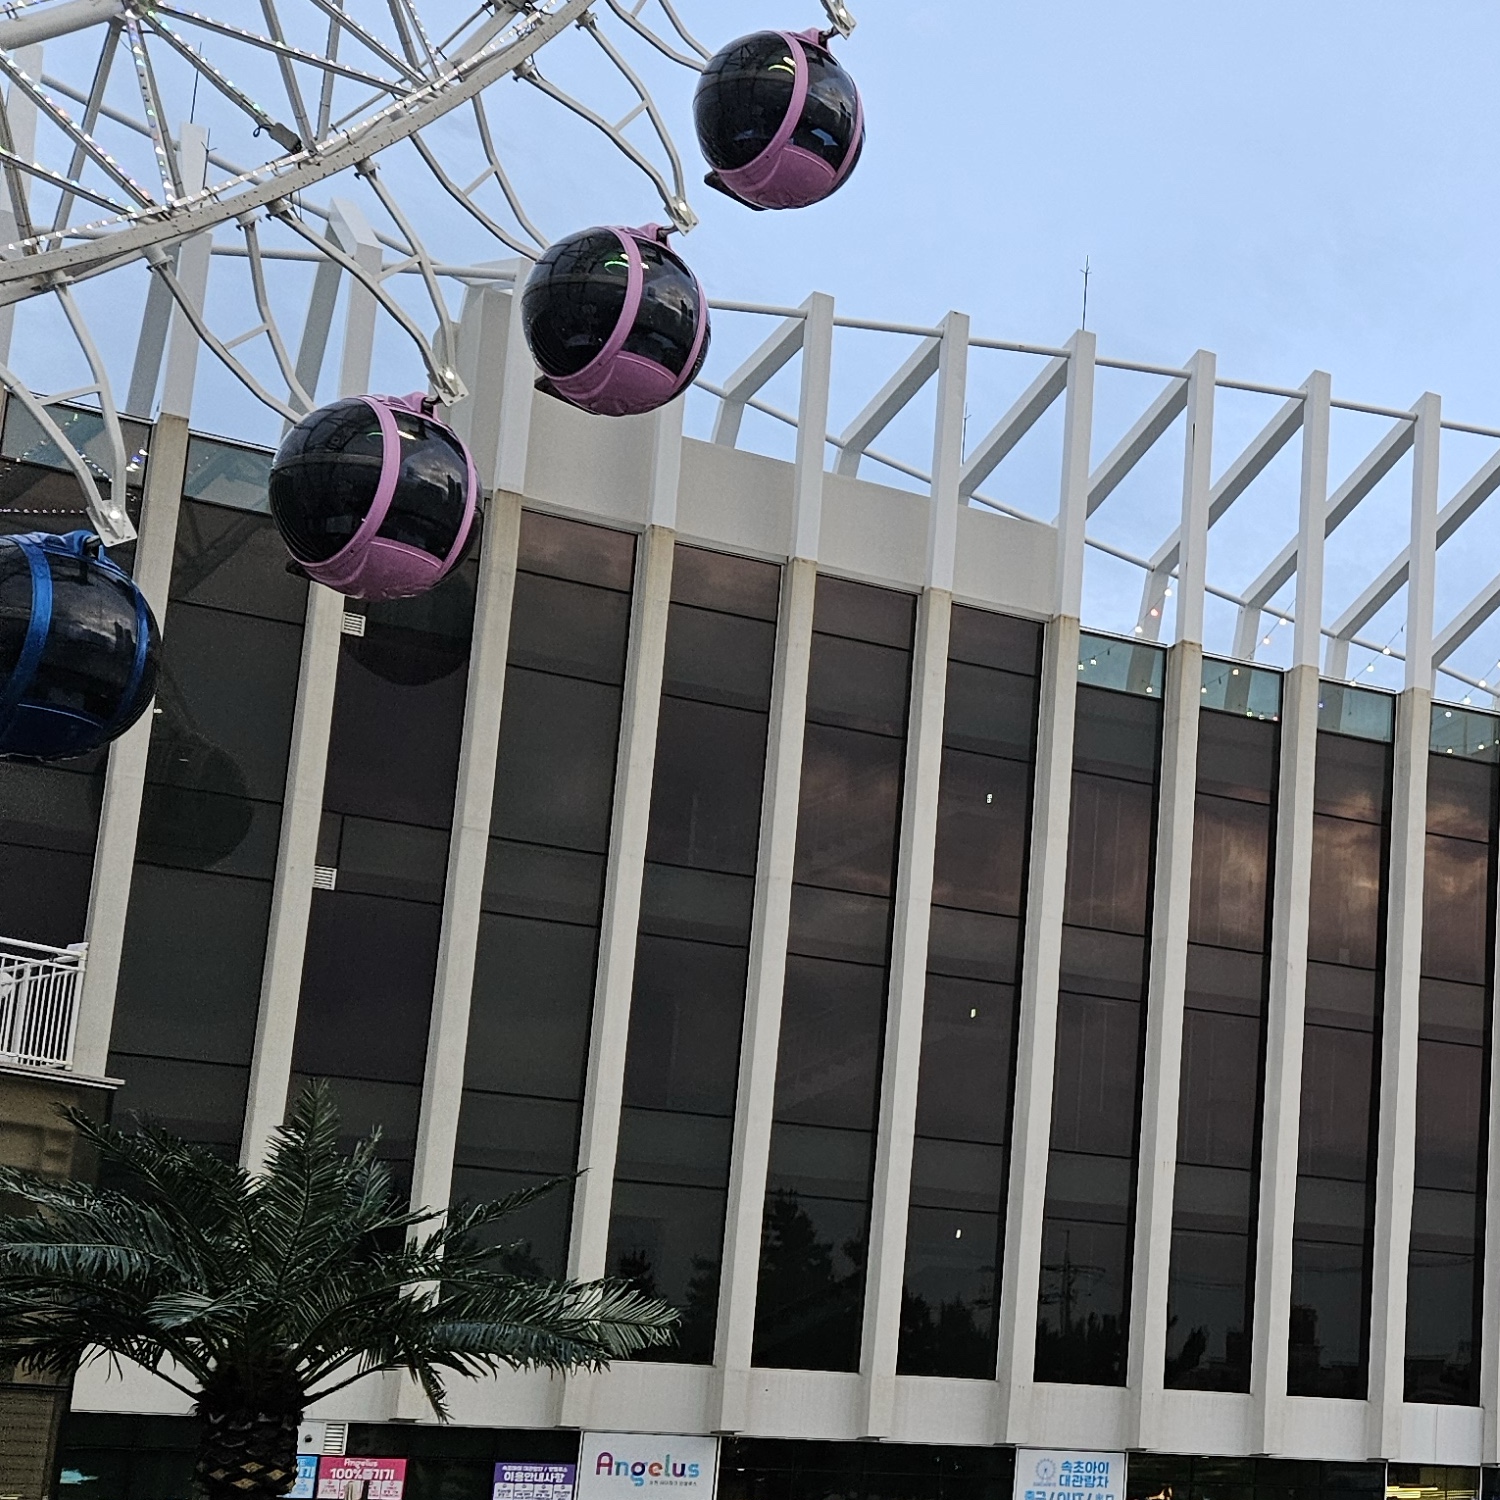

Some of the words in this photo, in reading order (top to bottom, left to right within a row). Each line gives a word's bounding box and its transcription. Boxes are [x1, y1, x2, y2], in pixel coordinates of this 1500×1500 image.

[595, 1451, 700, 1487] Angelus
[1061, 1460, 1109, 1474] 속초아이
[1059, 1474, 1109, 1488] 대관람차
